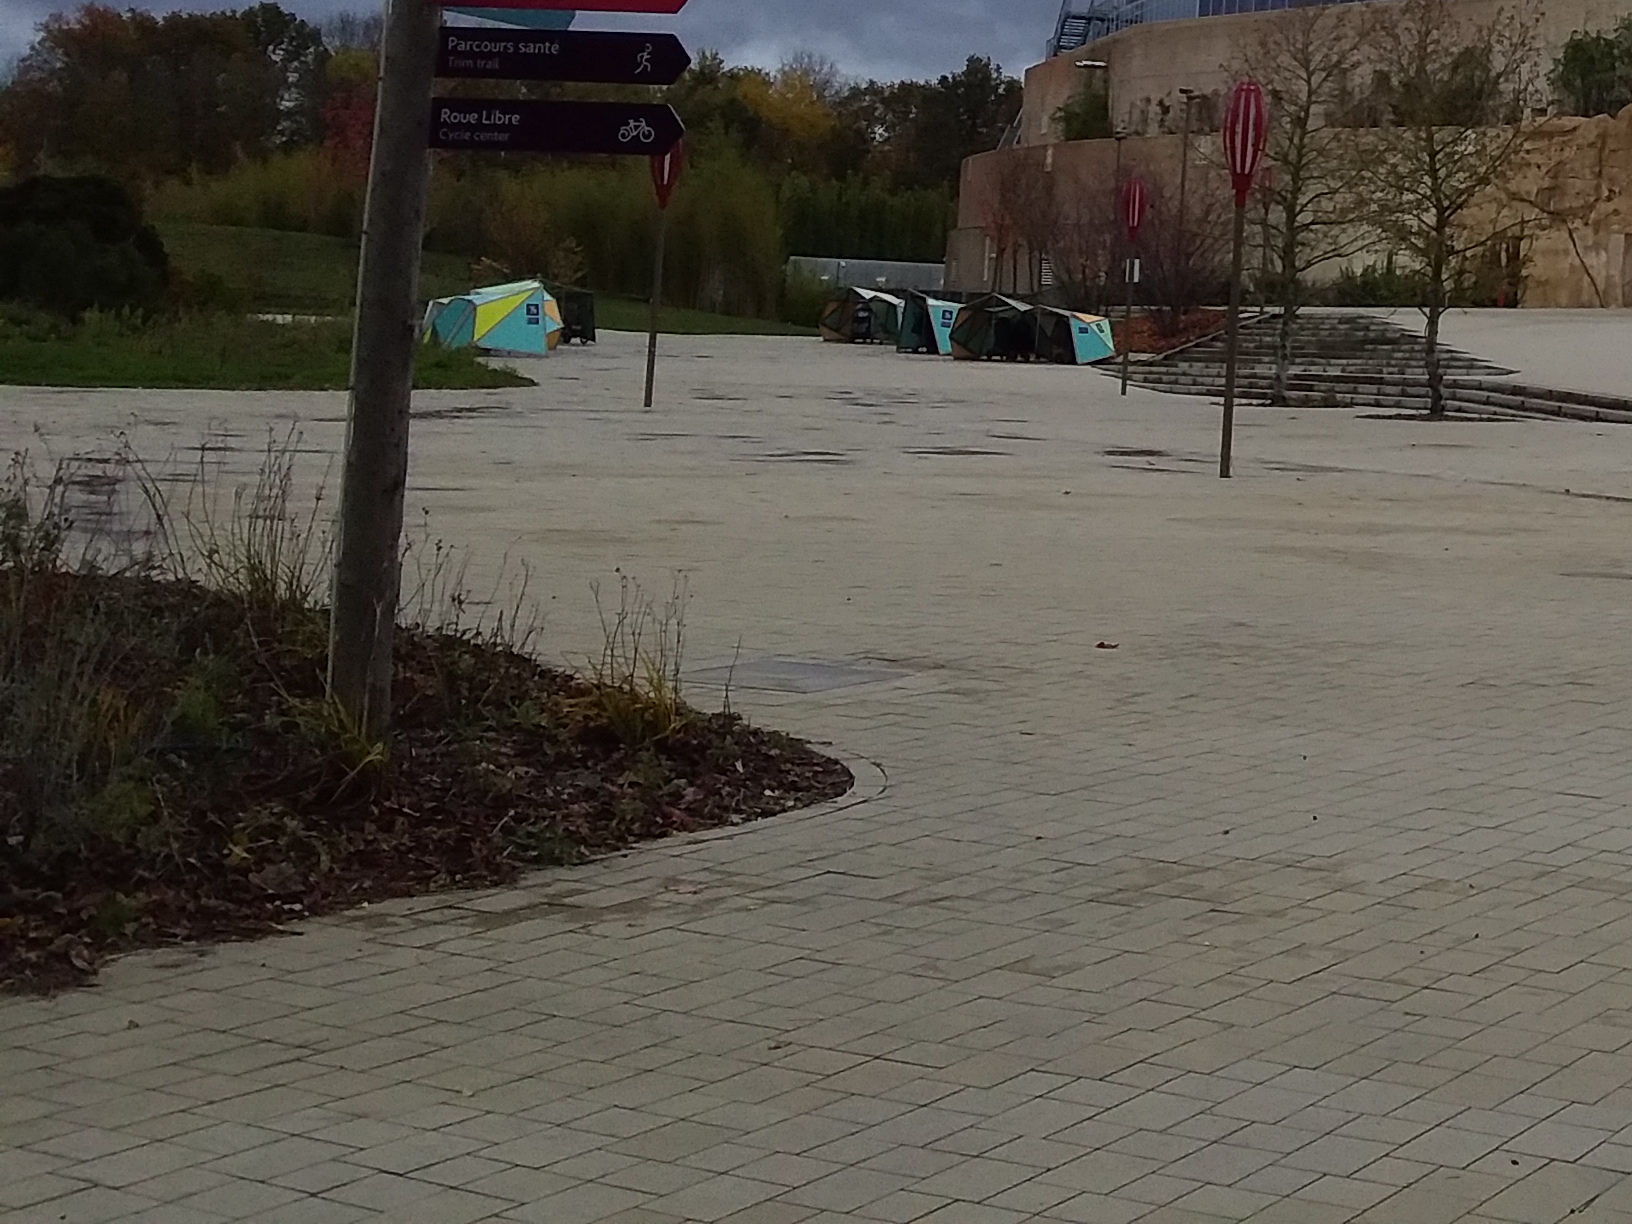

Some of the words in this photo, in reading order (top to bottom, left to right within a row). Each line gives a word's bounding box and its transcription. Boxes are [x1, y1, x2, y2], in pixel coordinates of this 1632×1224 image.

[447, 36, 514, 54] Parcours
[518, 39, 560, 55] santé
[447, 56, 474, 69] Trim
[477, 57, 500, 70] trail
[440, 108, 478, 124] Roue
[482, 109, 521, 125] Libre
[439, 128, 471, 142] Cycle
[473, 131, 511, 142] center
